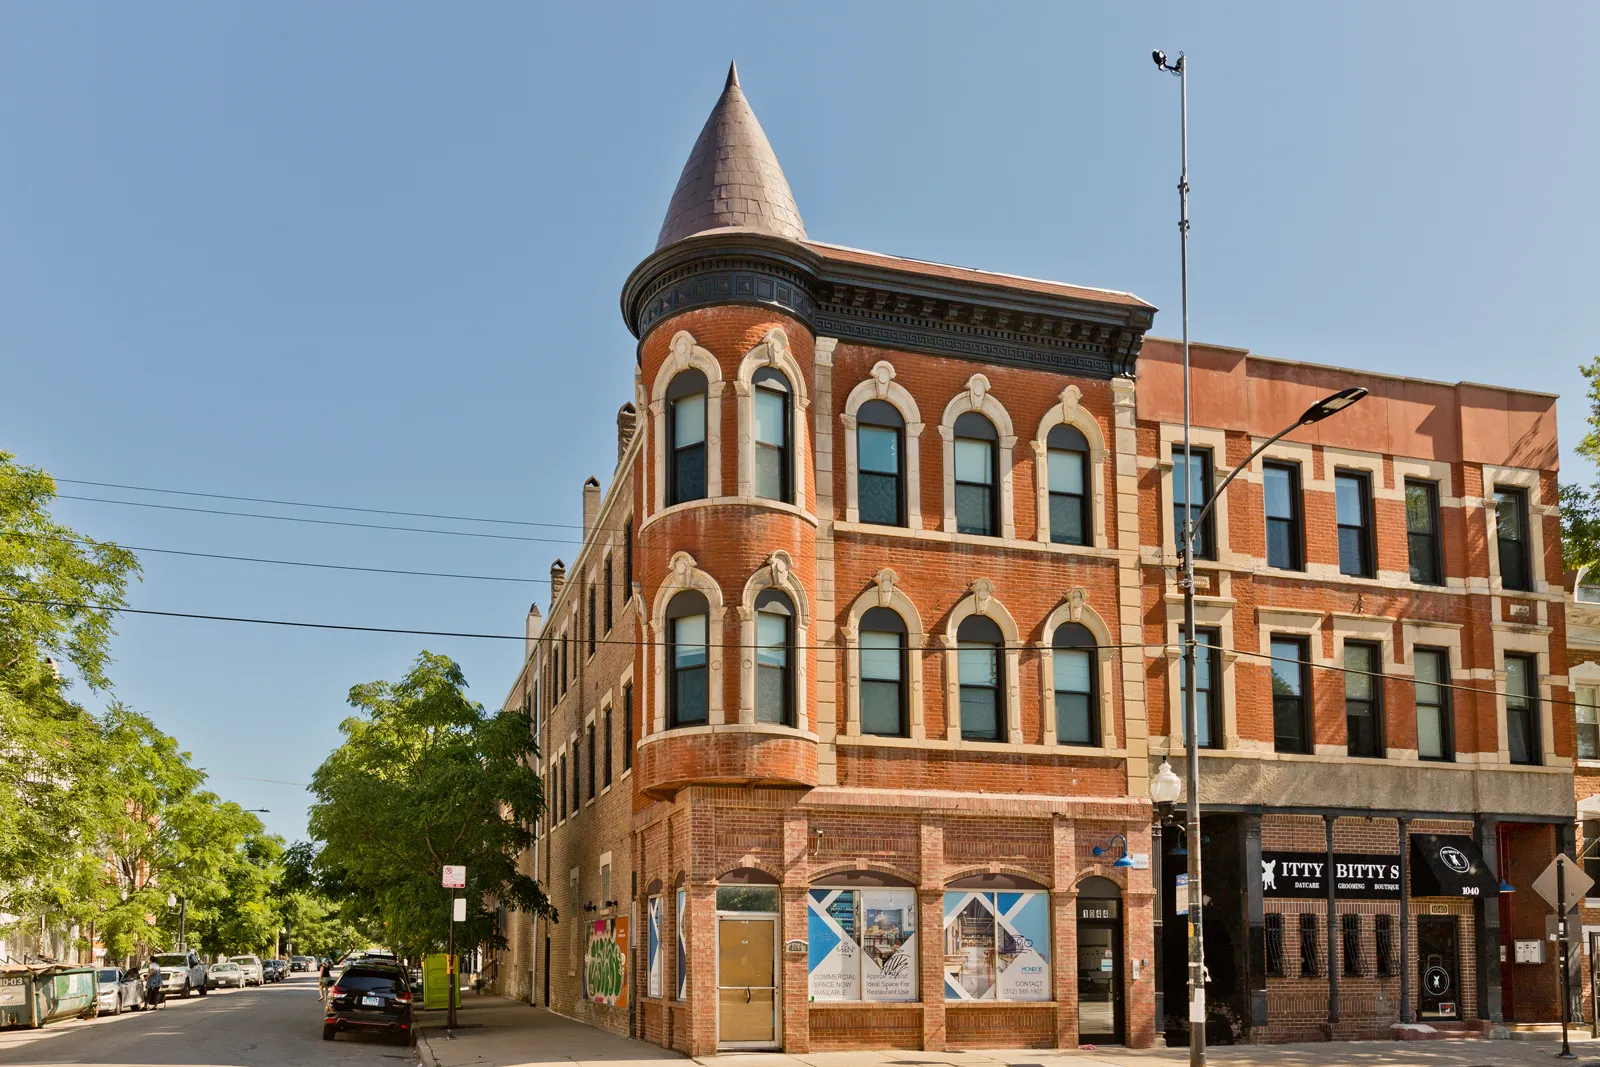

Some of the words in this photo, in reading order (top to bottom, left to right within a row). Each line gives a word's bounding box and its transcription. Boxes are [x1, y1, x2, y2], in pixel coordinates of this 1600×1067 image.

[1281, 862, 1324, 878] ITTY
[1294, 881, 1320, 889] DAYCARE
[1462, 886, 1480, 895] 1040
